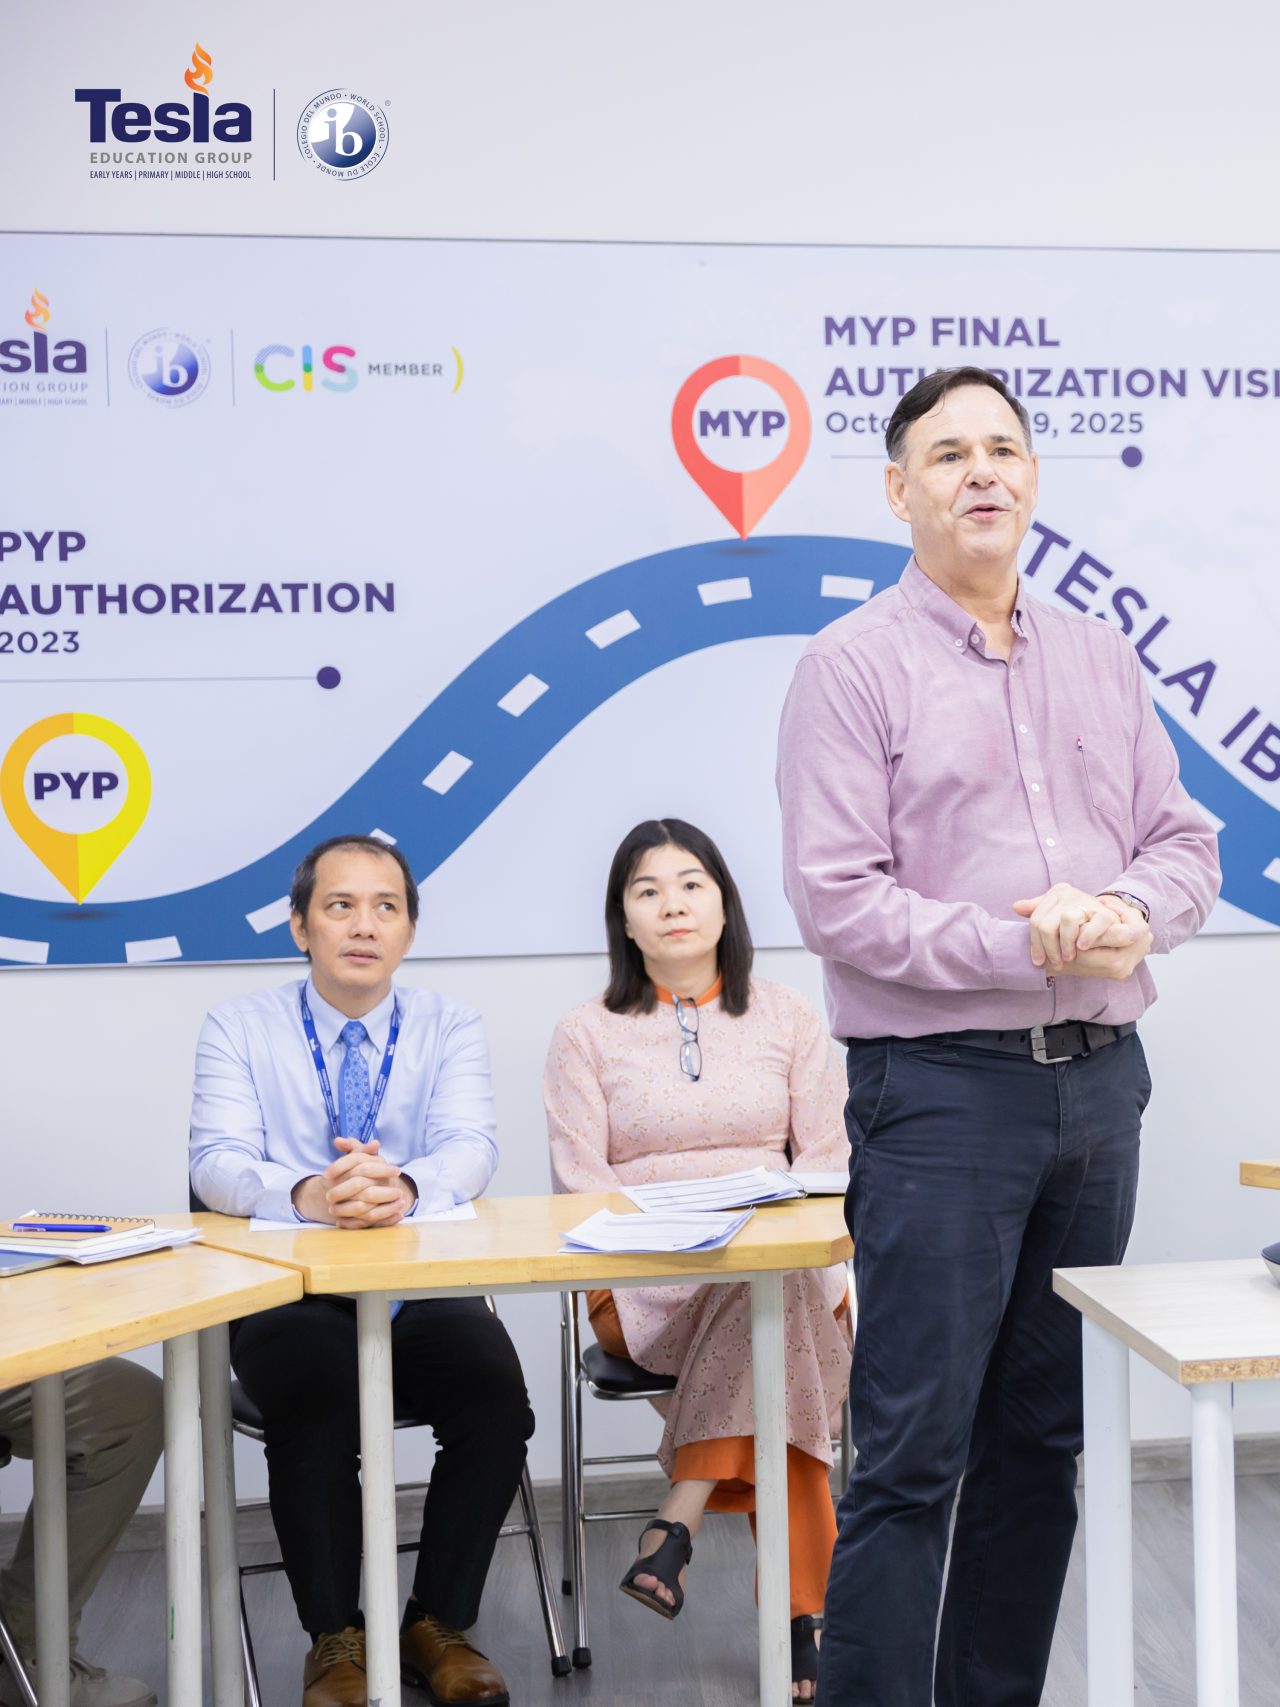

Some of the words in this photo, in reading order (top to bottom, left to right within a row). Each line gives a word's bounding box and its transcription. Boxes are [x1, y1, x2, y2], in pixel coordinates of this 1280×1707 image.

[824, 316, 917, 347] MYP
[931, 317, 1061, 348] FINAL
[253, 344, 359, 393] CIS
[368, 363, 443, 377] MEMBER
[824, 367, 1187, 398] AUTIZATION
[36, 382, 89, 392] GROUP
[699, 408, 787, 438] MYP
[1070, 412, 1144, 434] 2025
[0, 531, 87, 563] PYP
[0, 582, 396, 616] AUTHORIZATION
[1024, 520, 1217, 718] TESLA
[0, 630, 80, 653] 2023
[32, 771, 119, 801] PYP
